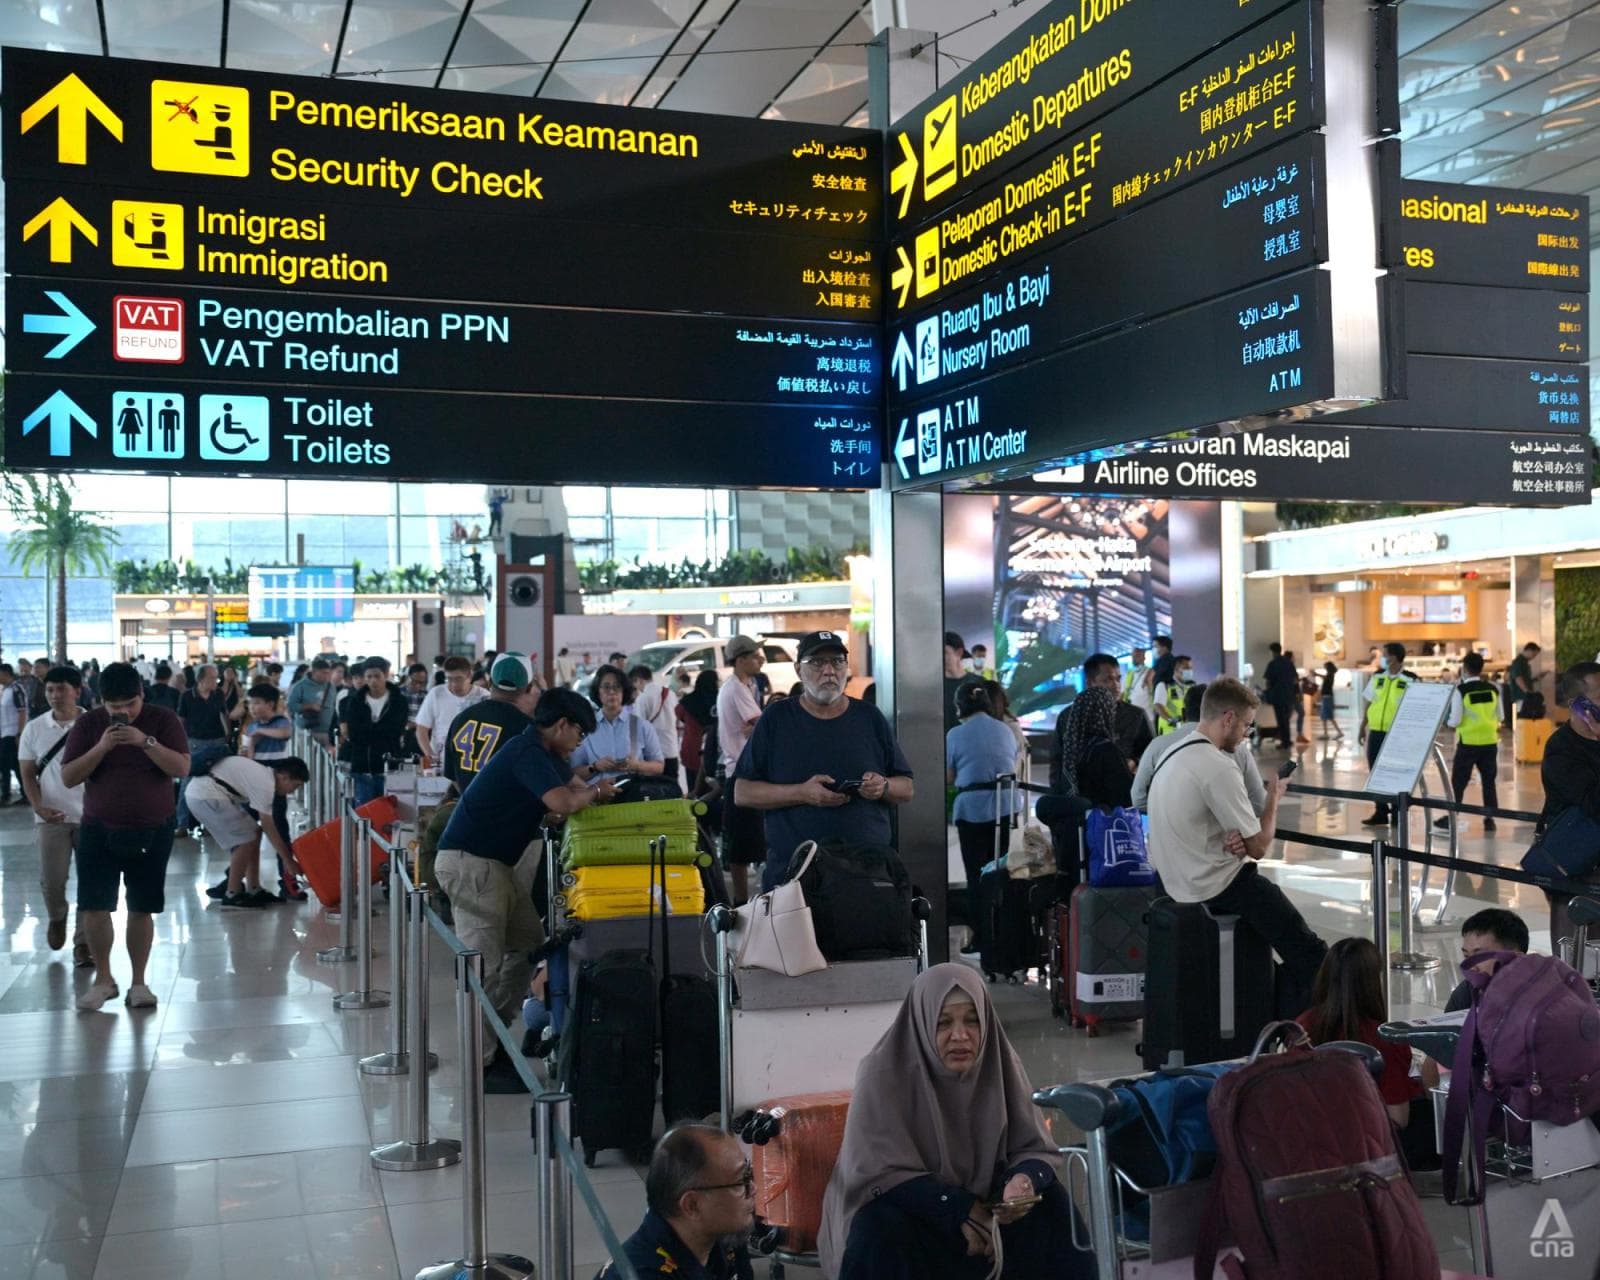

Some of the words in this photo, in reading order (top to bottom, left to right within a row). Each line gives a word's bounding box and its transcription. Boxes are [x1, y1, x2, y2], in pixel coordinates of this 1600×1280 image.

[961, 14, 1076, 118] Keberangkatan
[1233, 52, 1255, 84] السفر
[1201, 67, 1231, 98] الداخلية
[1179, 85, 1199, 112] E-F
[269, 90, 505, 141] Pemeriksaan
[518, 113, 699, 158] Keamanan
[962, 111, 1030, 178] Domestic
[1033, 49, 1132, 134] Departures
[792, 139, 825, 158] الأمني
[827, 145, 867, 160] التفتيش
[1112, 120, 1268, 208] 国内線チェックインカウンター
[1274, 100, 1297, 130] E-F
[271, 149, 420, 197] Security
[431, 161, 543, 199] Check
[1276, 163, 1298, 184] غرفة
[942, 197, 1002, 248] Pelaporan
[1004, 154, 1069, 215] Domestik
[1073, 133, 1102, 178] E-F
[198, 206, 326, 242] Imigrasi
[729, 200, 868, 223] セキュリティチェック
[1263, 194, 1300, 225] 母婴室
[943, 242, 998, 286] Domestic
[1000, 205, 1061, 257] Check-in
[1064, 183, 1093, 226] E-F
[1263, 230, 1300, 261] 授乳室
[198, 245, 388, 285] Immigration
[829, 250, 871, 264] الجوازات
[1403, 246, 1435, 268] es
[124, 304, 175, 326] VAT
[816, 292, 871, 309] 入国審査
[942, 304, 979, 338] Ruang
[983, 291, 1002, 321] Ibu
[1005, 282, 1016, 312] &
[1020, 266, 1050, 307] Bayi
[1260, 294, 1300, 320] الصرافات
[199, 299, 430, 340] Pengembalian
[440, 313, 510, 343] PPN
[120, 336, 178, 349] REFUND
[736, 330, 774, 342] المضافة
[776, 332, 802, 346] القيمة
[804, 334, 836, 348] ضريبة
[839, 337, 872, 351] استرداد
[942, 338, 987, 376] Nursery
[991, 324, 1030, 358] Room
[1242, 329, 1301, 365] 自动取款机
[200, 339, 272, 369] VAT
[285, 343, 399, 375] Refund
[816, 357, 872, 373] 离境退税
[1269, 367, 1301, 393] ATM
[284, 397, 374, 428] Toilet
[814, 416, 837, 430] المياه
[840, 418, 871, 432] دورات
[944, 396, 979, 432] ATM
[284, 435, 391, 465] Toilets
[830, 439, 871, 454] 洗手间
[945, 435, 980, 470] ATM
[983, 429, 1027, 461] Center
[1243, 432, 1351, 463] Maskapai
[833, 461, 872, 475] トイレ
[1094, 460, 1169, 485] Airline
[1175, 461, 1258, 488] Offices
[1511, 459, 1585, 475] 航空公司办公室
[1103, 554, 1152, 576] Airport
[453, 719, 503, 773] 47
